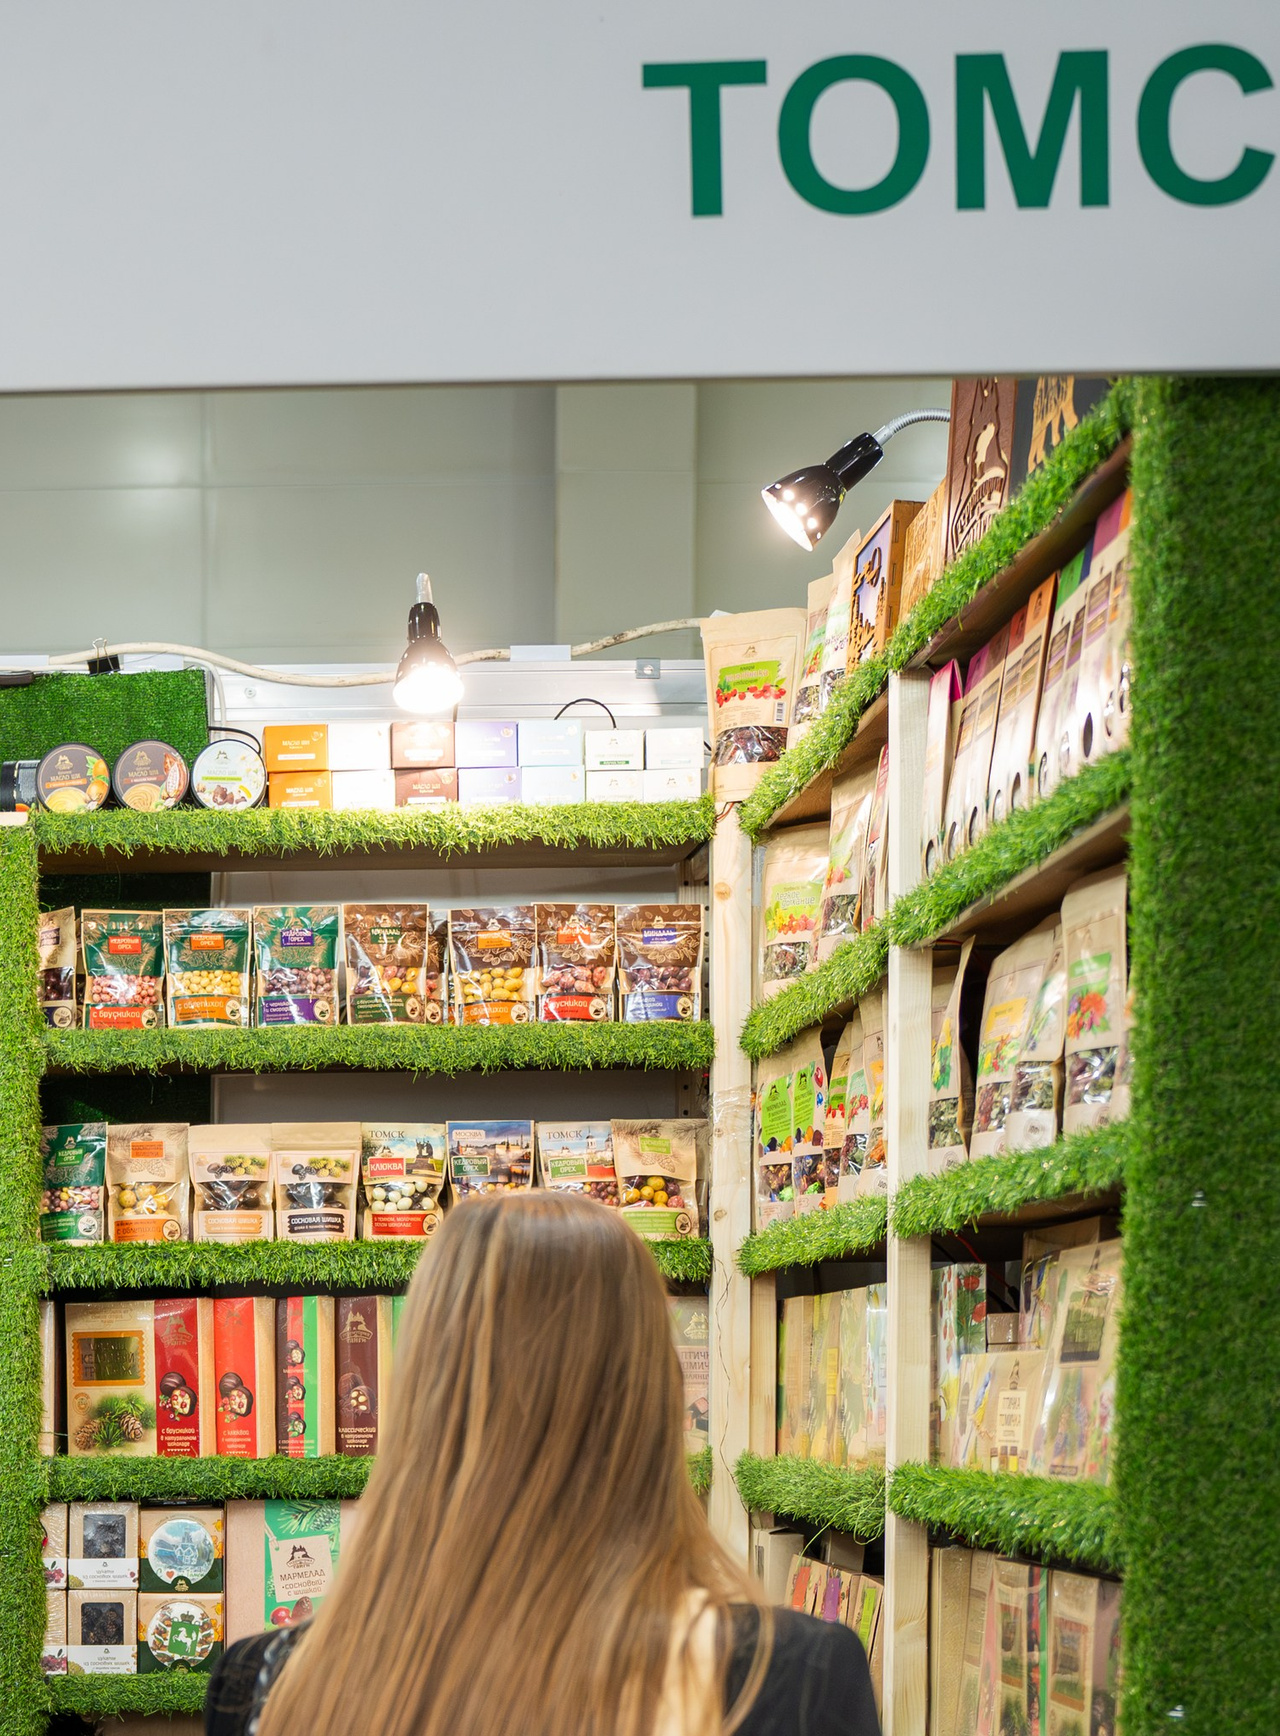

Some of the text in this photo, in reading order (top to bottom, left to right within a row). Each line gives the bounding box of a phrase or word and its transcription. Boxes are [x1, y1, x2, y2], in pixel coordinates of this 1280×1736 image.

[642, 41, 1276, 218] ТОМС
[99, 1010, 141, 1020] брусникой
[369, 1130, 405, 1138] ТОМСК
[546, 1130, 583, 1140] ТОМСК
[453, 1158, 488, 1166] КЕДРОВЫЙ
[550, 1159, 585, 1168] КЕДРОВЫЙ
[370, 1163, 403, 1171] КЛЮКВА
[291, 1216, 342, 1225] СОСНОВАЯ ШИШКА
[280, 1569, 326, 1581] МАРМЕЛАД
